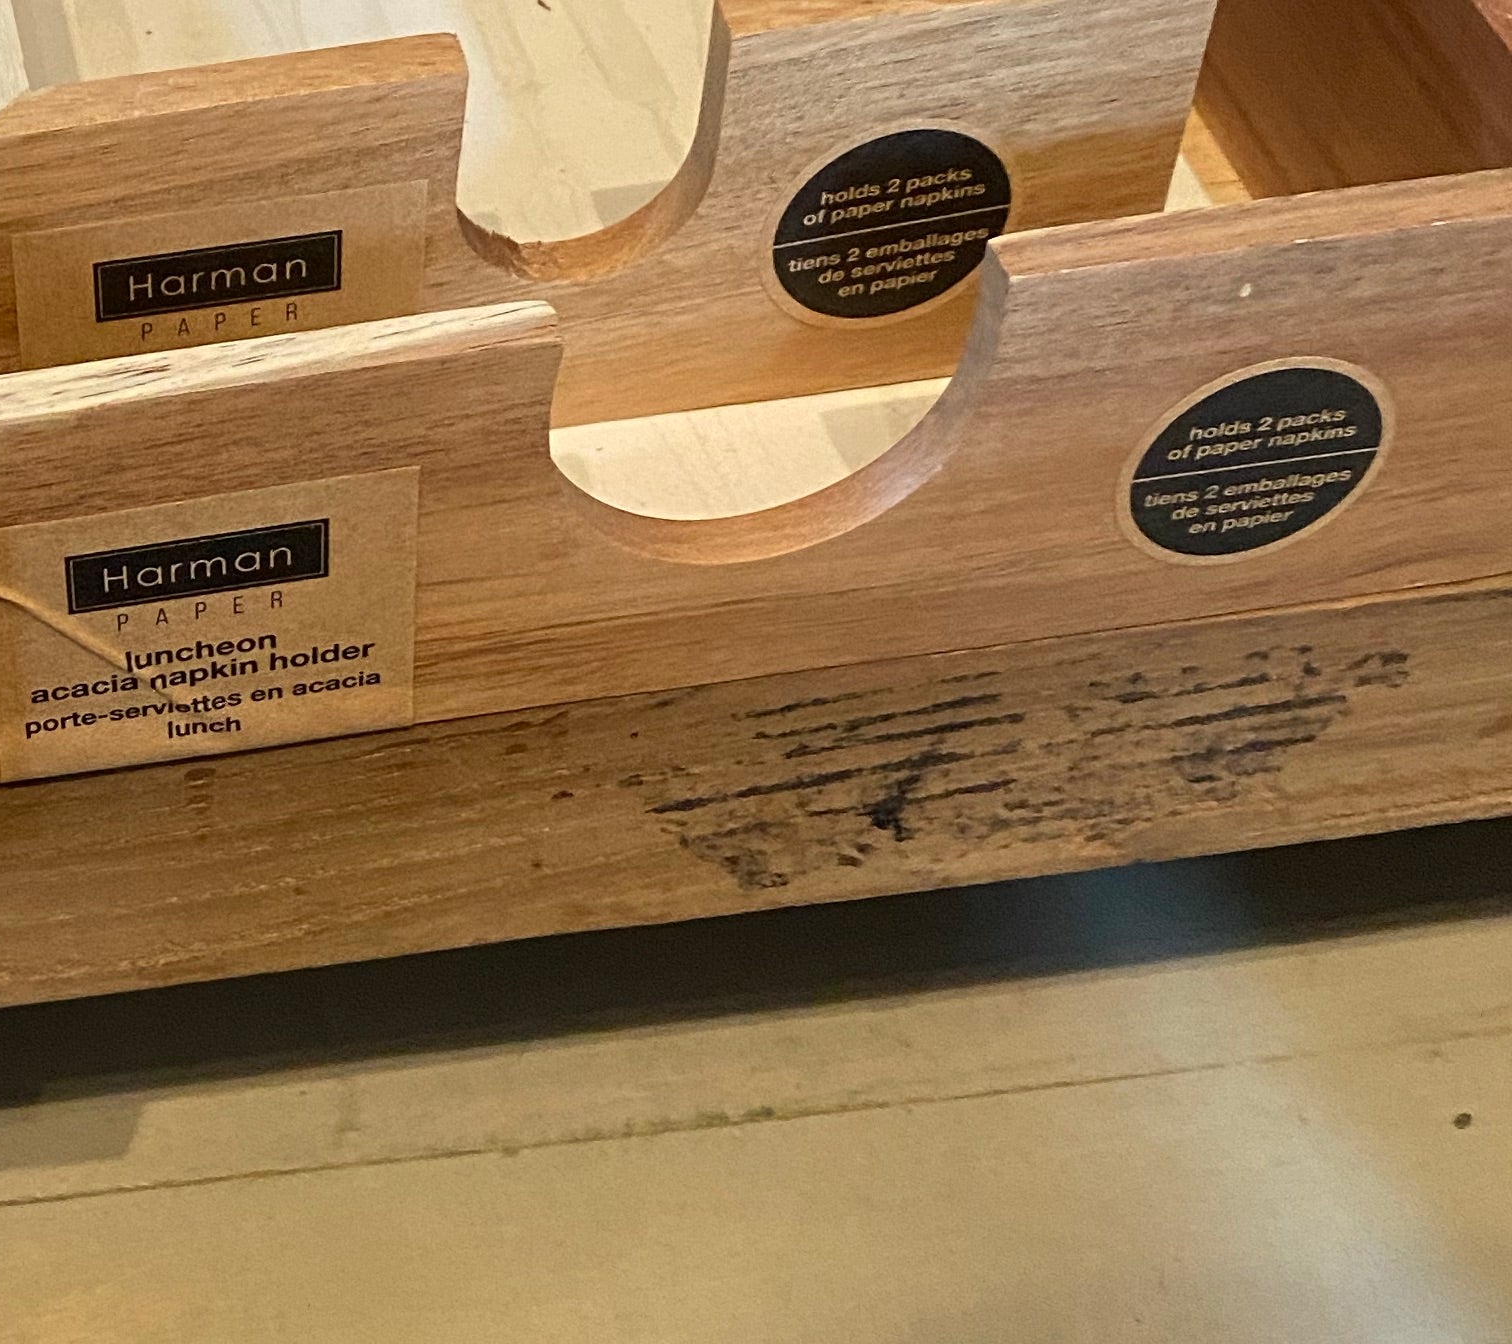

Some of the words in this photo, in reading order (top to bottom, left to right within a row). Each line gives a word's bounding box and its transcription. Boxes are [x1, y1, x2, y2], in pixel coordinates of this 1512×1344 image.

[803, 211, 825, 226] of
[831, 199, 893, 224] paper
[900, 182, 986, 208] napkins
[821, 181, 880, 206] holds
[888, 179, 900, 192] 2
[906, 167, 973, 193] packs
[788, 253, 841, 272] tiens
[846, 247, 860, 262] 2
[866, 227, 989, 258] emballages
[818, 268, 845, 284] de
[851, 249, 955, 279] serviettes
[129, 258, 307, 301] Harman
[838, 283, 864, 297] en
[870, 269, 937, 295] papier
[142, 302, 298, 341] PAPER
[1167, 444, 1192, 462] of
[1195, 436, 1262, 461] paper
[1268, 424, 1357, 448] napkins
[1190, 420, 1251, 442] holds
[1258, 417, 1272, 431] 2
[1277, 408, 1347, 431] packs
[1144, 490, 1198, 508] tiens
[1204, 485, 1218, 500] 2
[1224, 468, 1352, 497] emballages
[1171, 504, 1200, 522] de
[1206, 491, 1315, 515] serviettes
[1188, 520, 1216, 534] en
[1222, 509, 1294, 533] papier
[102, 544, 293, 593] Harman
[116, 589, 284, 632] PAPER
[125, 632, 278, 673] luncheon
[31, 675, 140, 703] acacia
[150, 654, 259, 691] napkin
[269, 642, 375, 671] holder
[25, 693, 242, 739] porte-serviettes
[250, 684, 284, 702] en
[292, 670, 382, 697] acacia
[167, 717, 242, 739] lunch
